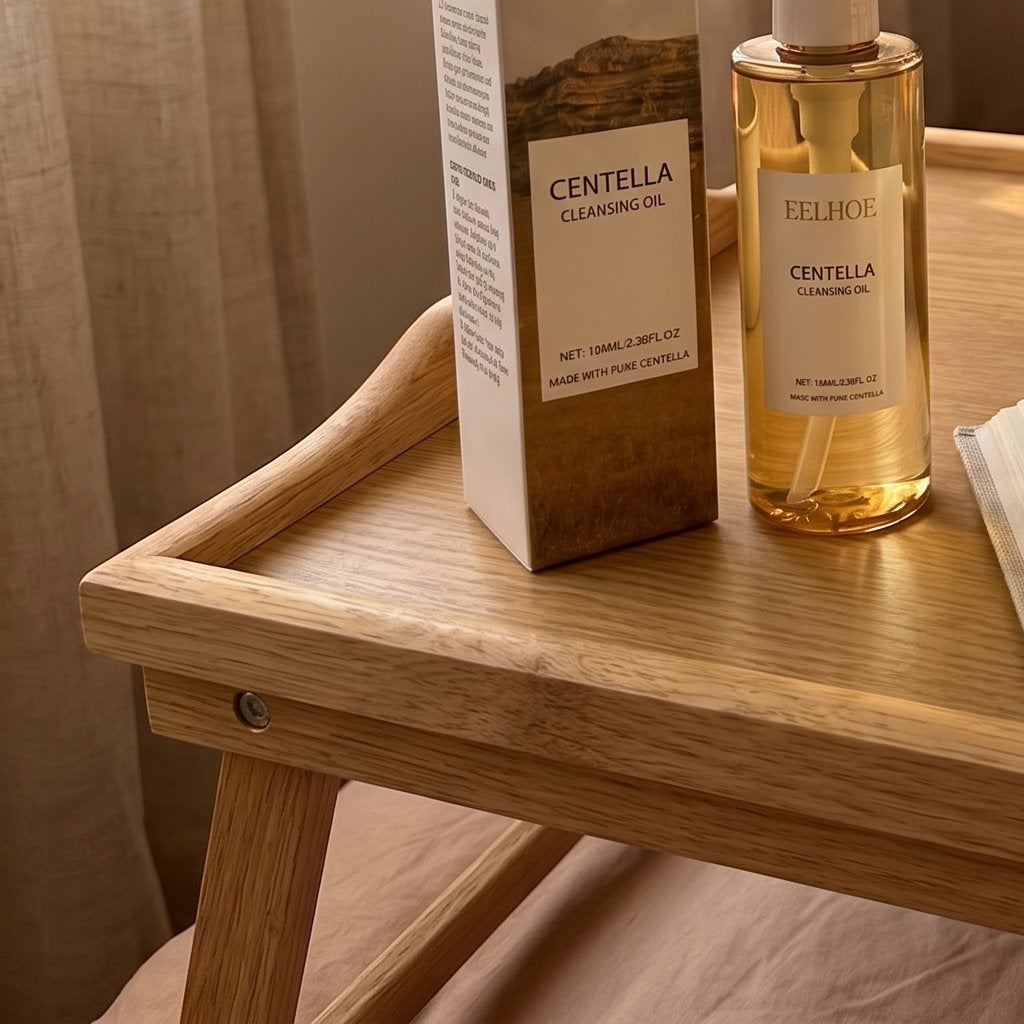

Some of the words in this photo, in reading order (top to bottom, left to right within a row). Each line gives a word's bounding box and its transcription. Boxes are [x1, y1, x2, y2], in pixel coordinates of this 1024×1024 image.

[549, 162, 674, 201] CENTELLA
[561, 197, 640, 224] CLEANSING
[642, 193, 666, 209] OIL
[784, 197, 877, 222] EELHOE
[790, 263, 876, 281] CENTELLA
[797, 285, 852, 296] CLEANSING
[853, 284, 870, 294] OIL
[560, 348, 586, 362] NET:
[663, 327, 681, 339] OZ
[549, 373, 580, 388] MADE
[582, 367, 608, 381] WITH
[639, 350, 690, 368] CENTELLA
[795, 378, 812, 386] NET:
[866, 374, 877, 383] OZ
[849, 390, 884, 401] CENTELLA
